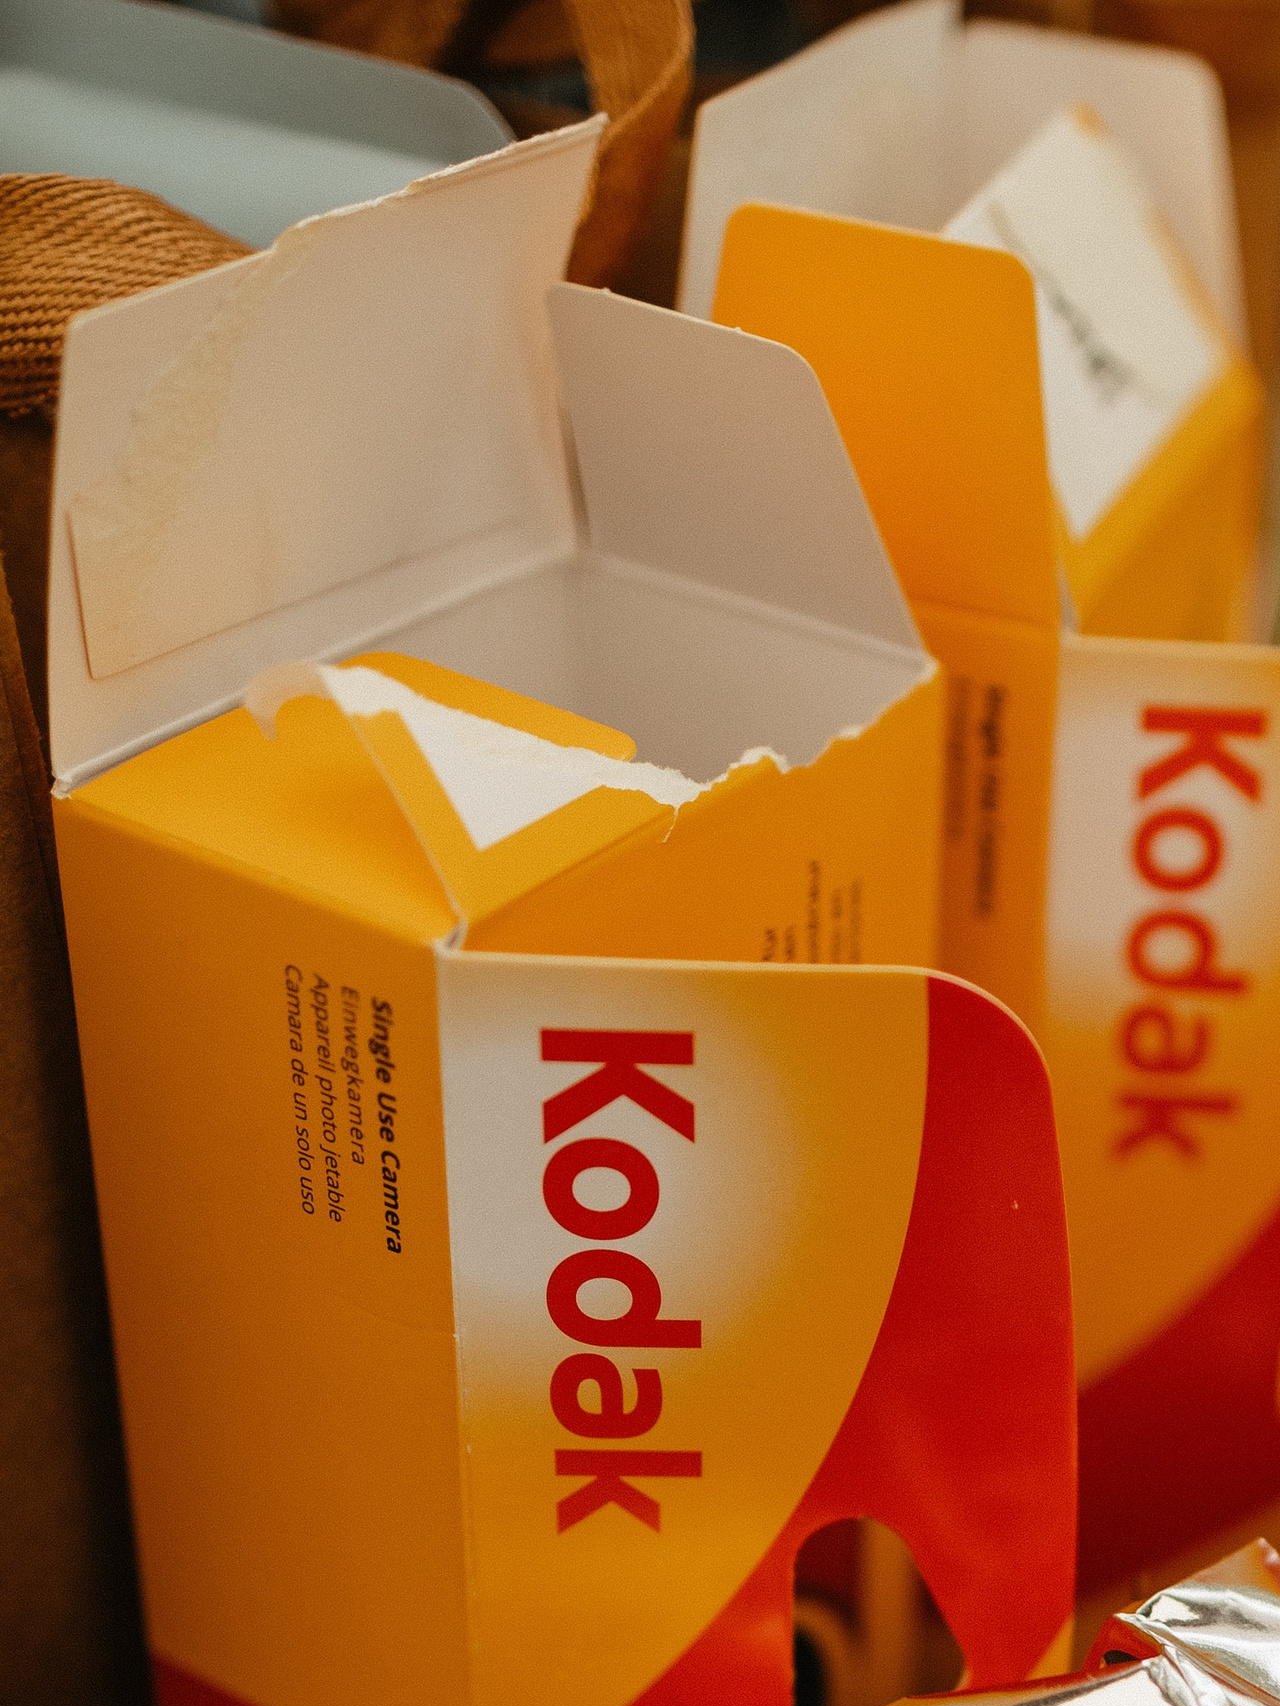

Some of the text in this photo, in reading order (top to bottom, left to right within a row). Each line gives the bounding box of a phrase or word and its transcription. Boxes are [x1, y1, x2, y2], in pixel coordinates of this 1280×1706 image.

[1111, 704, 1271, 1163] Kodak
[285, 963, 316, 1215] Camara de un solo uso
[310, 973, 346, 1223] Appareil photo jetable
[340, 985, 365, 1166] Einwegkamera
[368, 996, 402, 1254] Single Use Camera
[539, 1027, 703, 1535] Kodak
